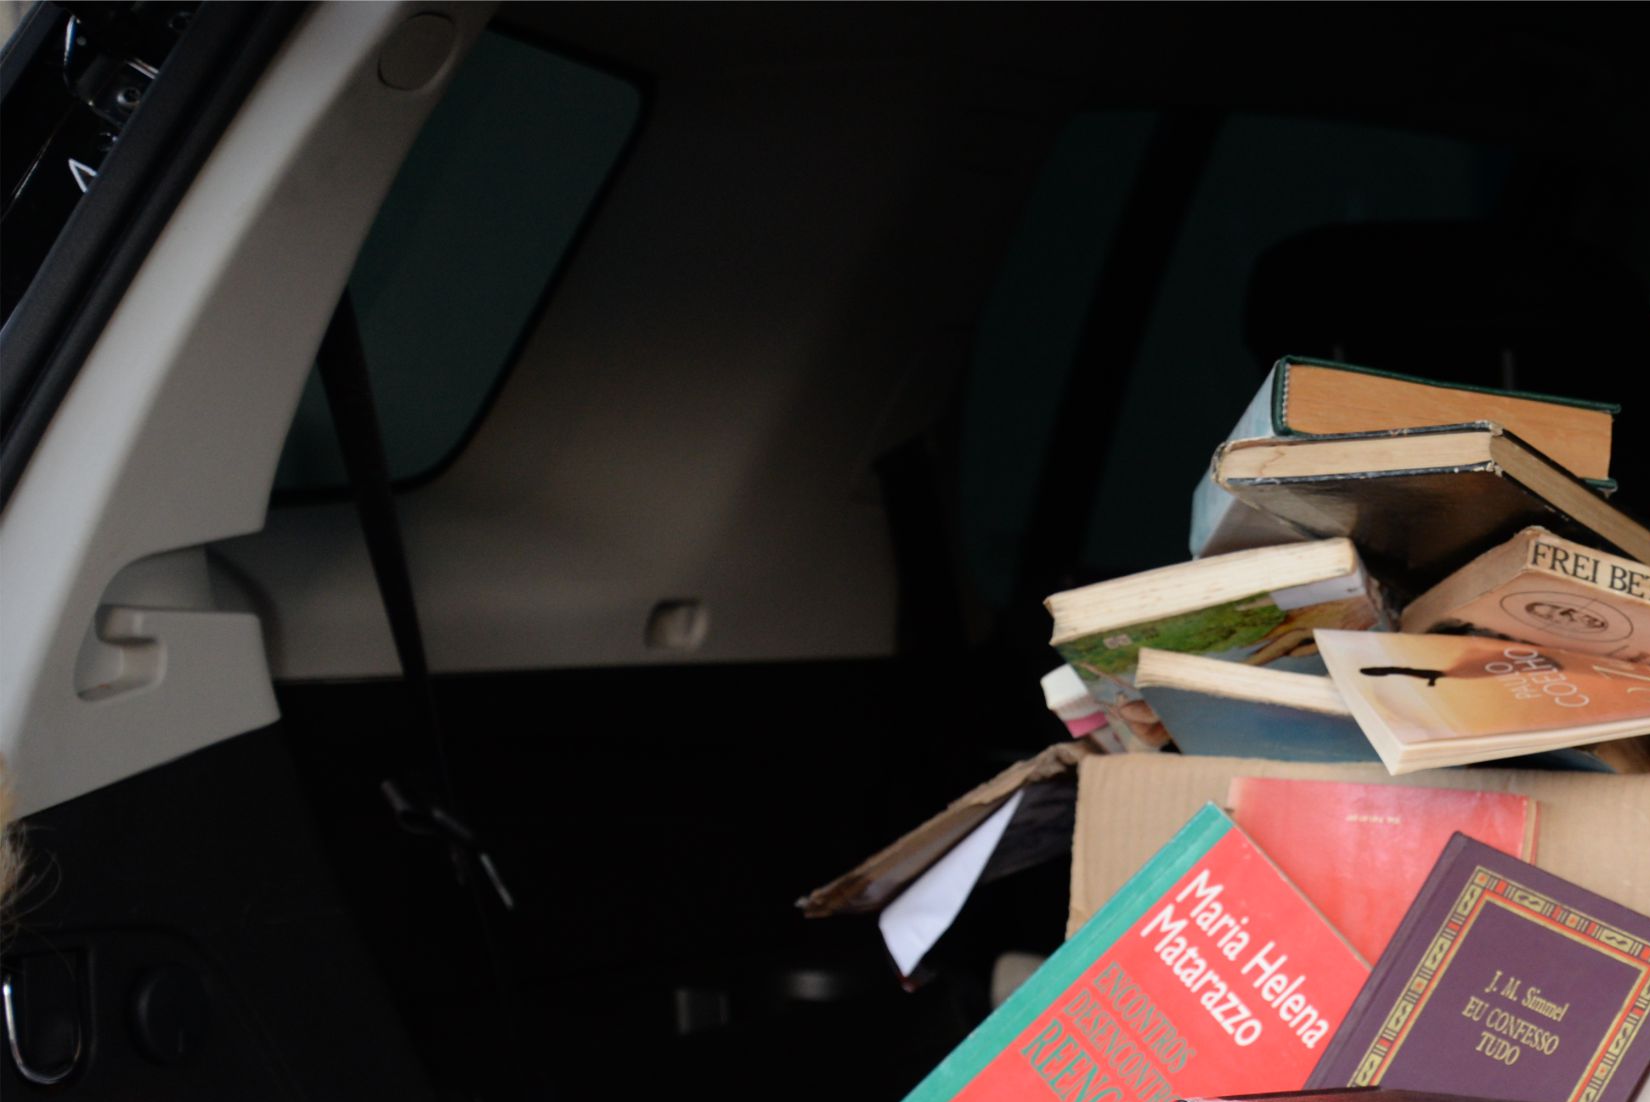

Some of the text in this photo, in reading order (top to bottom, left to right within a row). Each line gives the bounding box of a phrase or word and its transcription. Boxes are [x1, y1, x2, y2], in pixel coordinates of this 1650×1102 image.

[1530, 542, 1599, 585] FREI
[1503, 646, 1590, 709] COELHO
[1139, 903, 1264, 1048] Matarazzo
[1174, 868, 1331, 1051] Maria Helena
[1092, 961, 1198, 1075] ENCONTROS
[1462, 996, 1560, 1056] EU CONFESSO
[1484, 969, 1570, 1022] J. M. Simmel
[1475, 1031, 1520, 1065] TUDO
